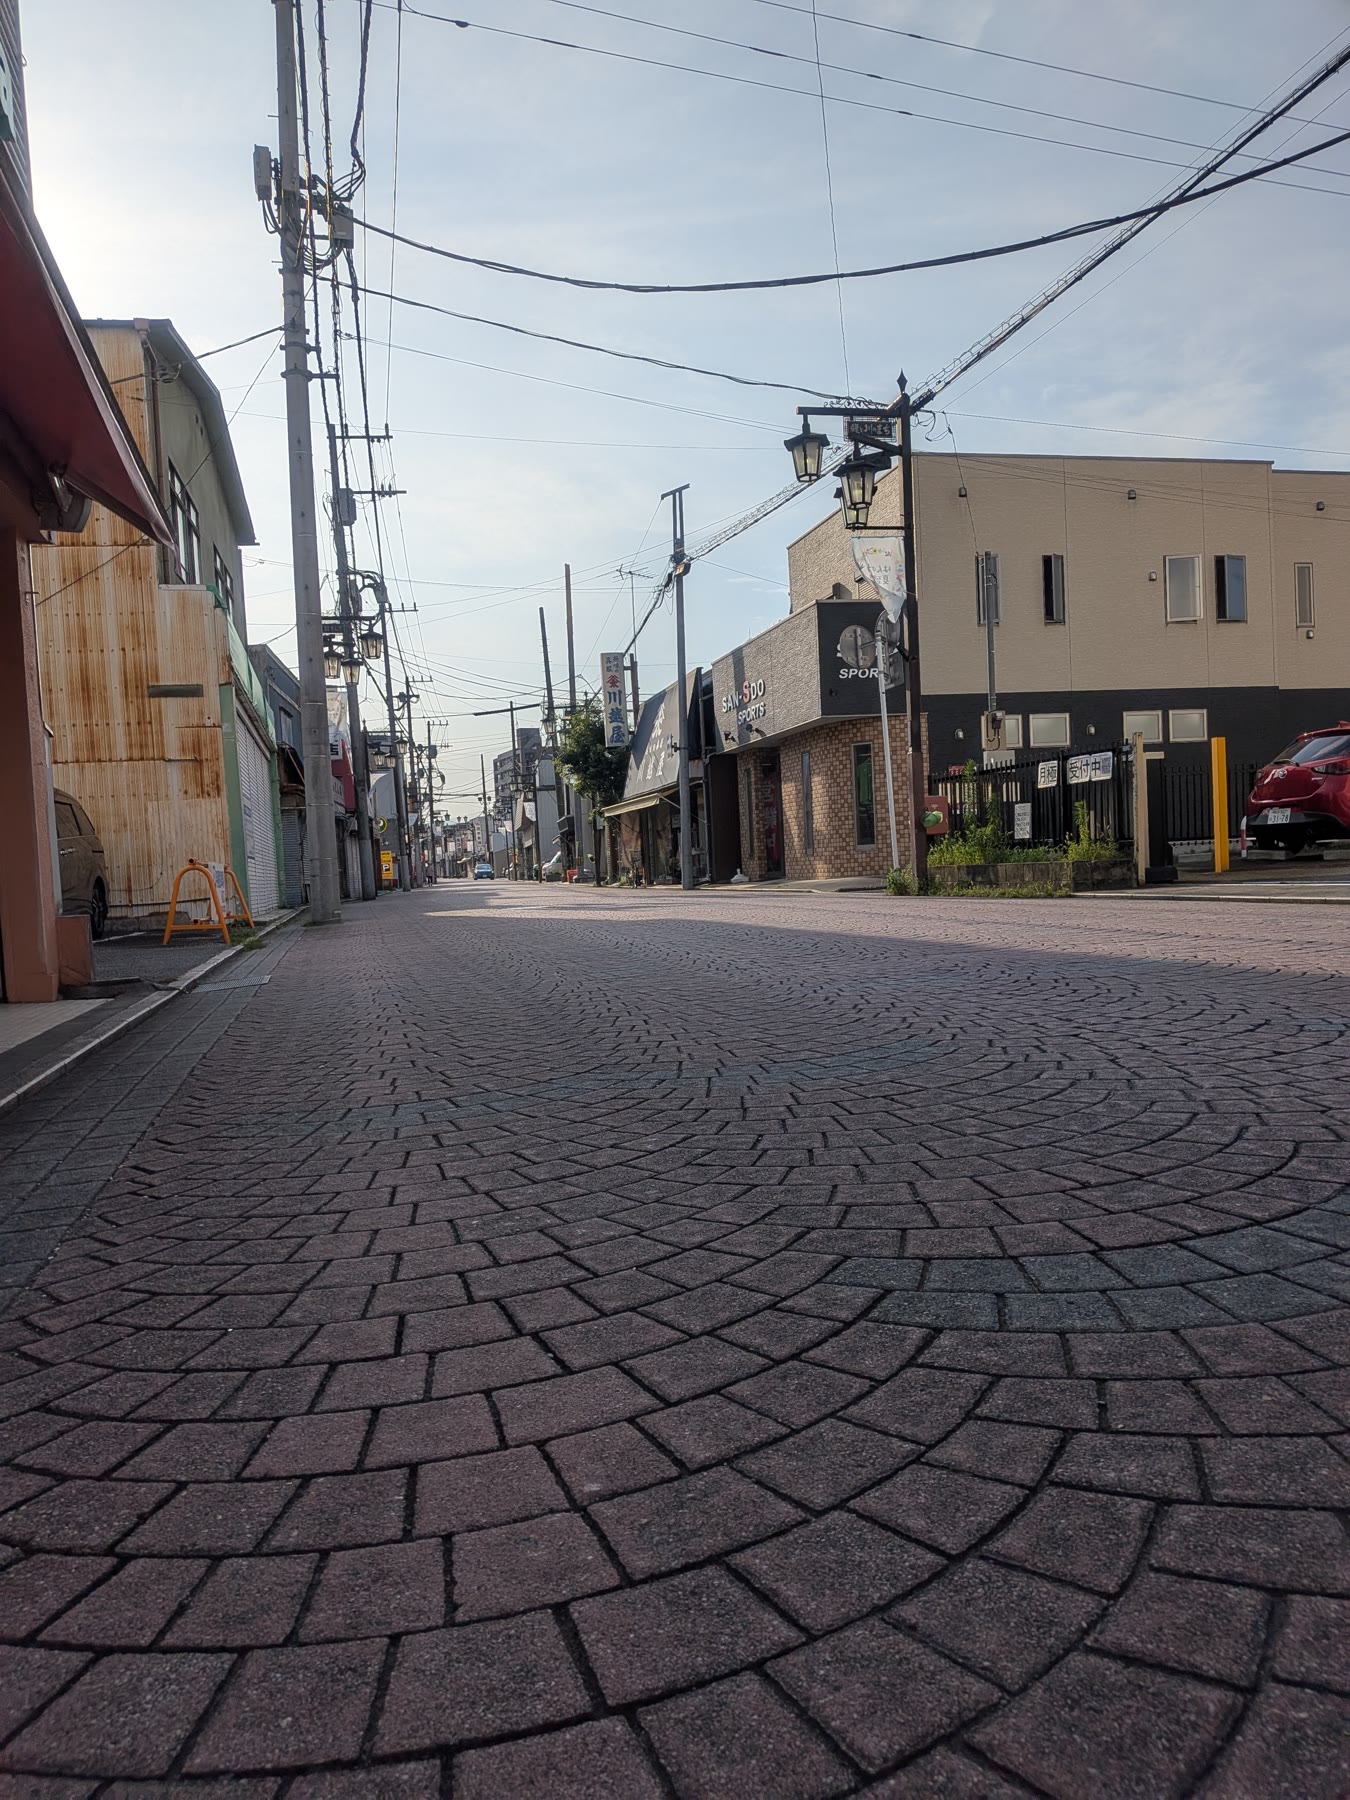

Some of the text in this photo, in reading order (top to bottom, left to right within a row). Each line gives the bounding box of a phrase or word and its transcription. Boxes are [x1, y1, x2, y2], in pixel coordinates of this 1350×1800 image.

[737, 701, 765, 725] SPORTS
[1039, 765, 1057, 784] 月極
[1069, 758, 1101, 779] 受付中
